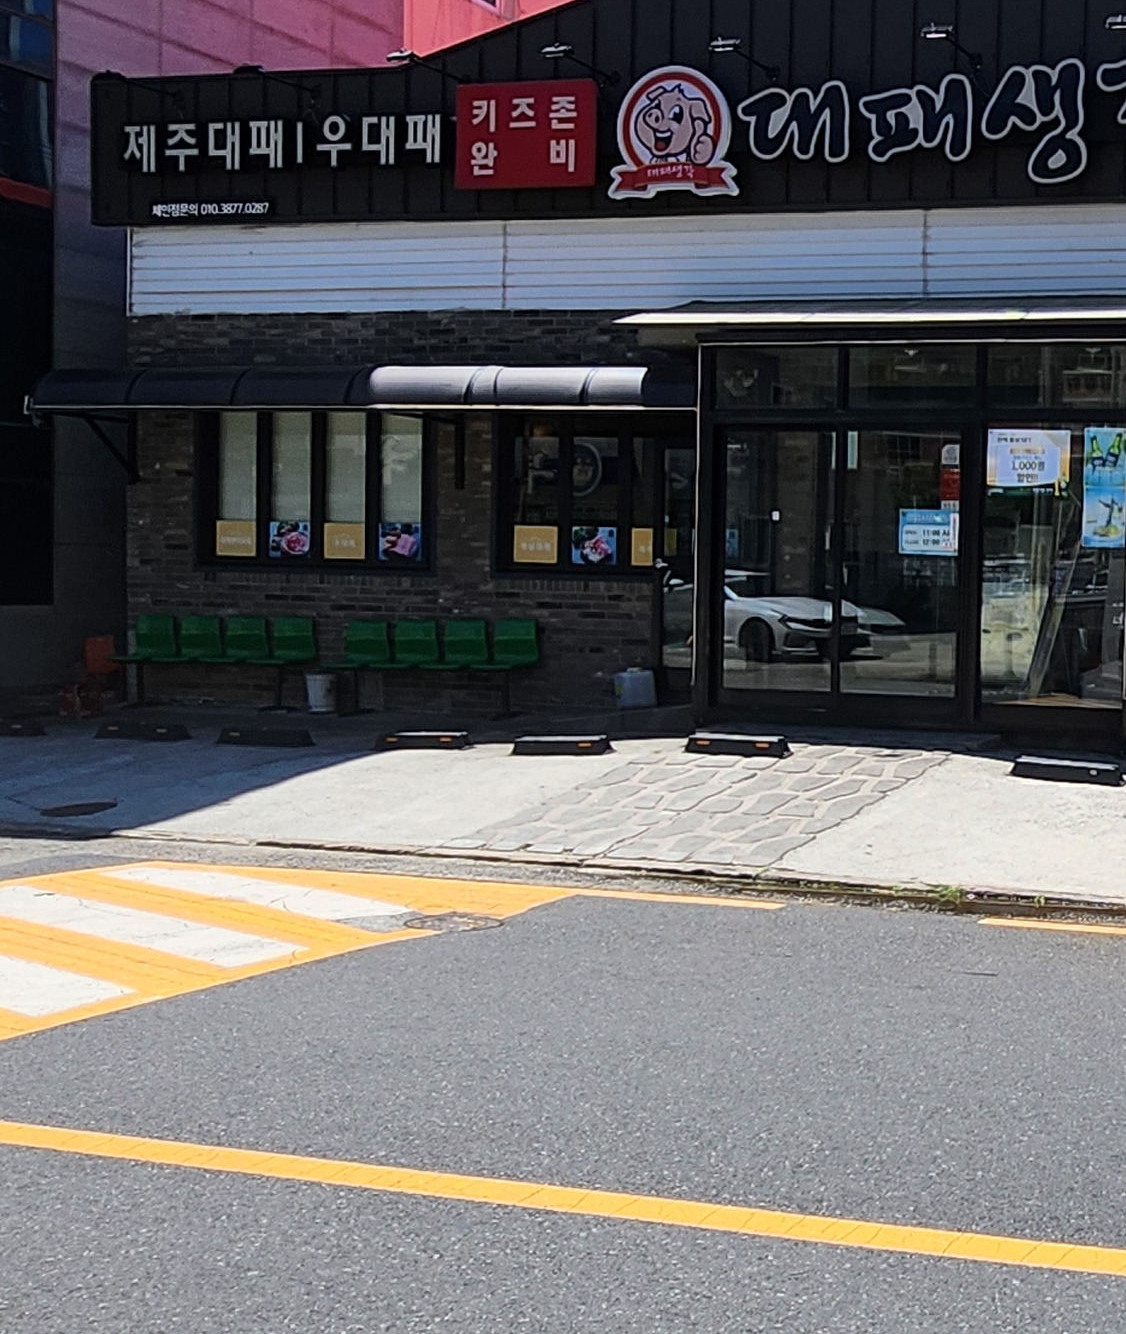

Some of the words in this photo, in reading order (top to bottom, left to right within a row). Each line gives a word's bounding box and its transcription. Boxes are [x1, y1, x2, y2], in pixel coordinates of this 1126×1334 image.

[471, 96, 578, 133] 키즈존
[122, 120, 284, 174] 제주대패
[315, 113, 442, 167] 우대패
